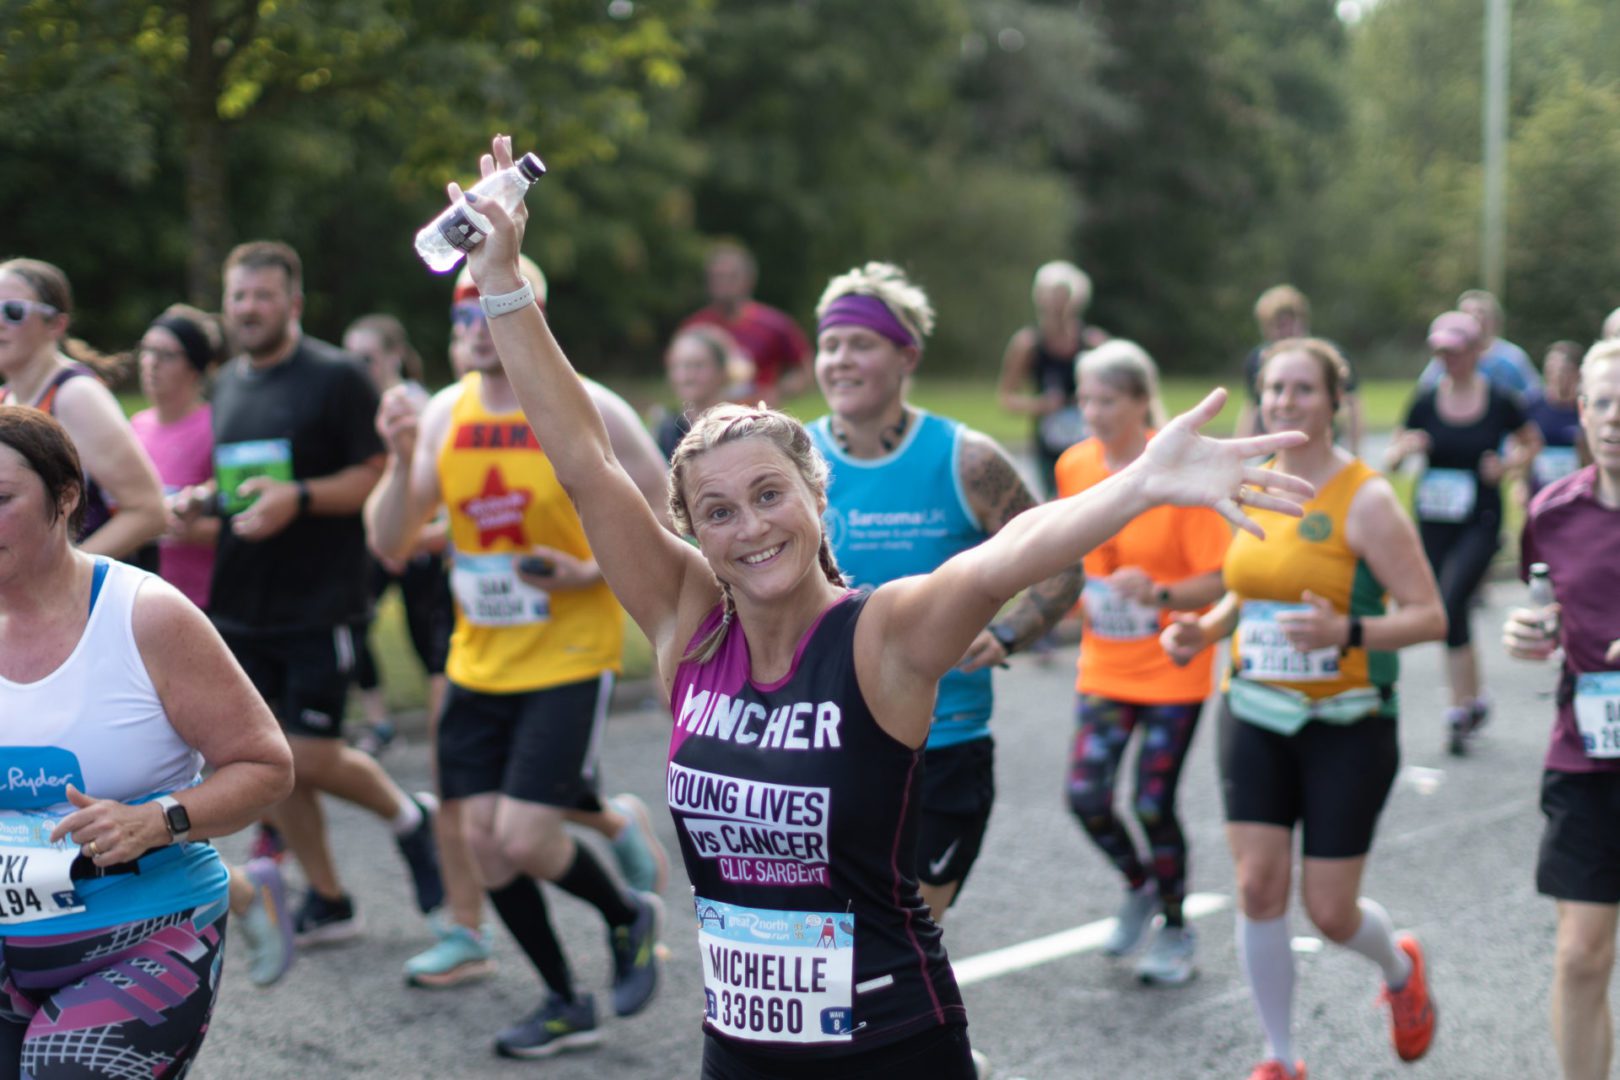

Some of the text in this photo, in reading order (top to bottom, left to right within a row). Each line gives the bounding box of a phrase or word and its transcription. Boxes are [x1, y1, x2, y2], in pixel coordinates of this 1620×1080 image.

[472, 426, 529, 448] SAM
[677, 683, 842, 750] MINCHER
[7, 767, 73, 797] Ryder
[669, 766, 823, 826] YOUNG LIVES
[720, 824, 824, 860] CANCER
[719, 858, 827, 886] CLIC SARGENT
[759, 920, 789, 931] north
[708, 943, 828, 993] MICHELLE
[721, 989, 803, 1035] 33660
[829, 1011, 845, 1019] WAVE
[834, 1019, 841, 1031] 8
